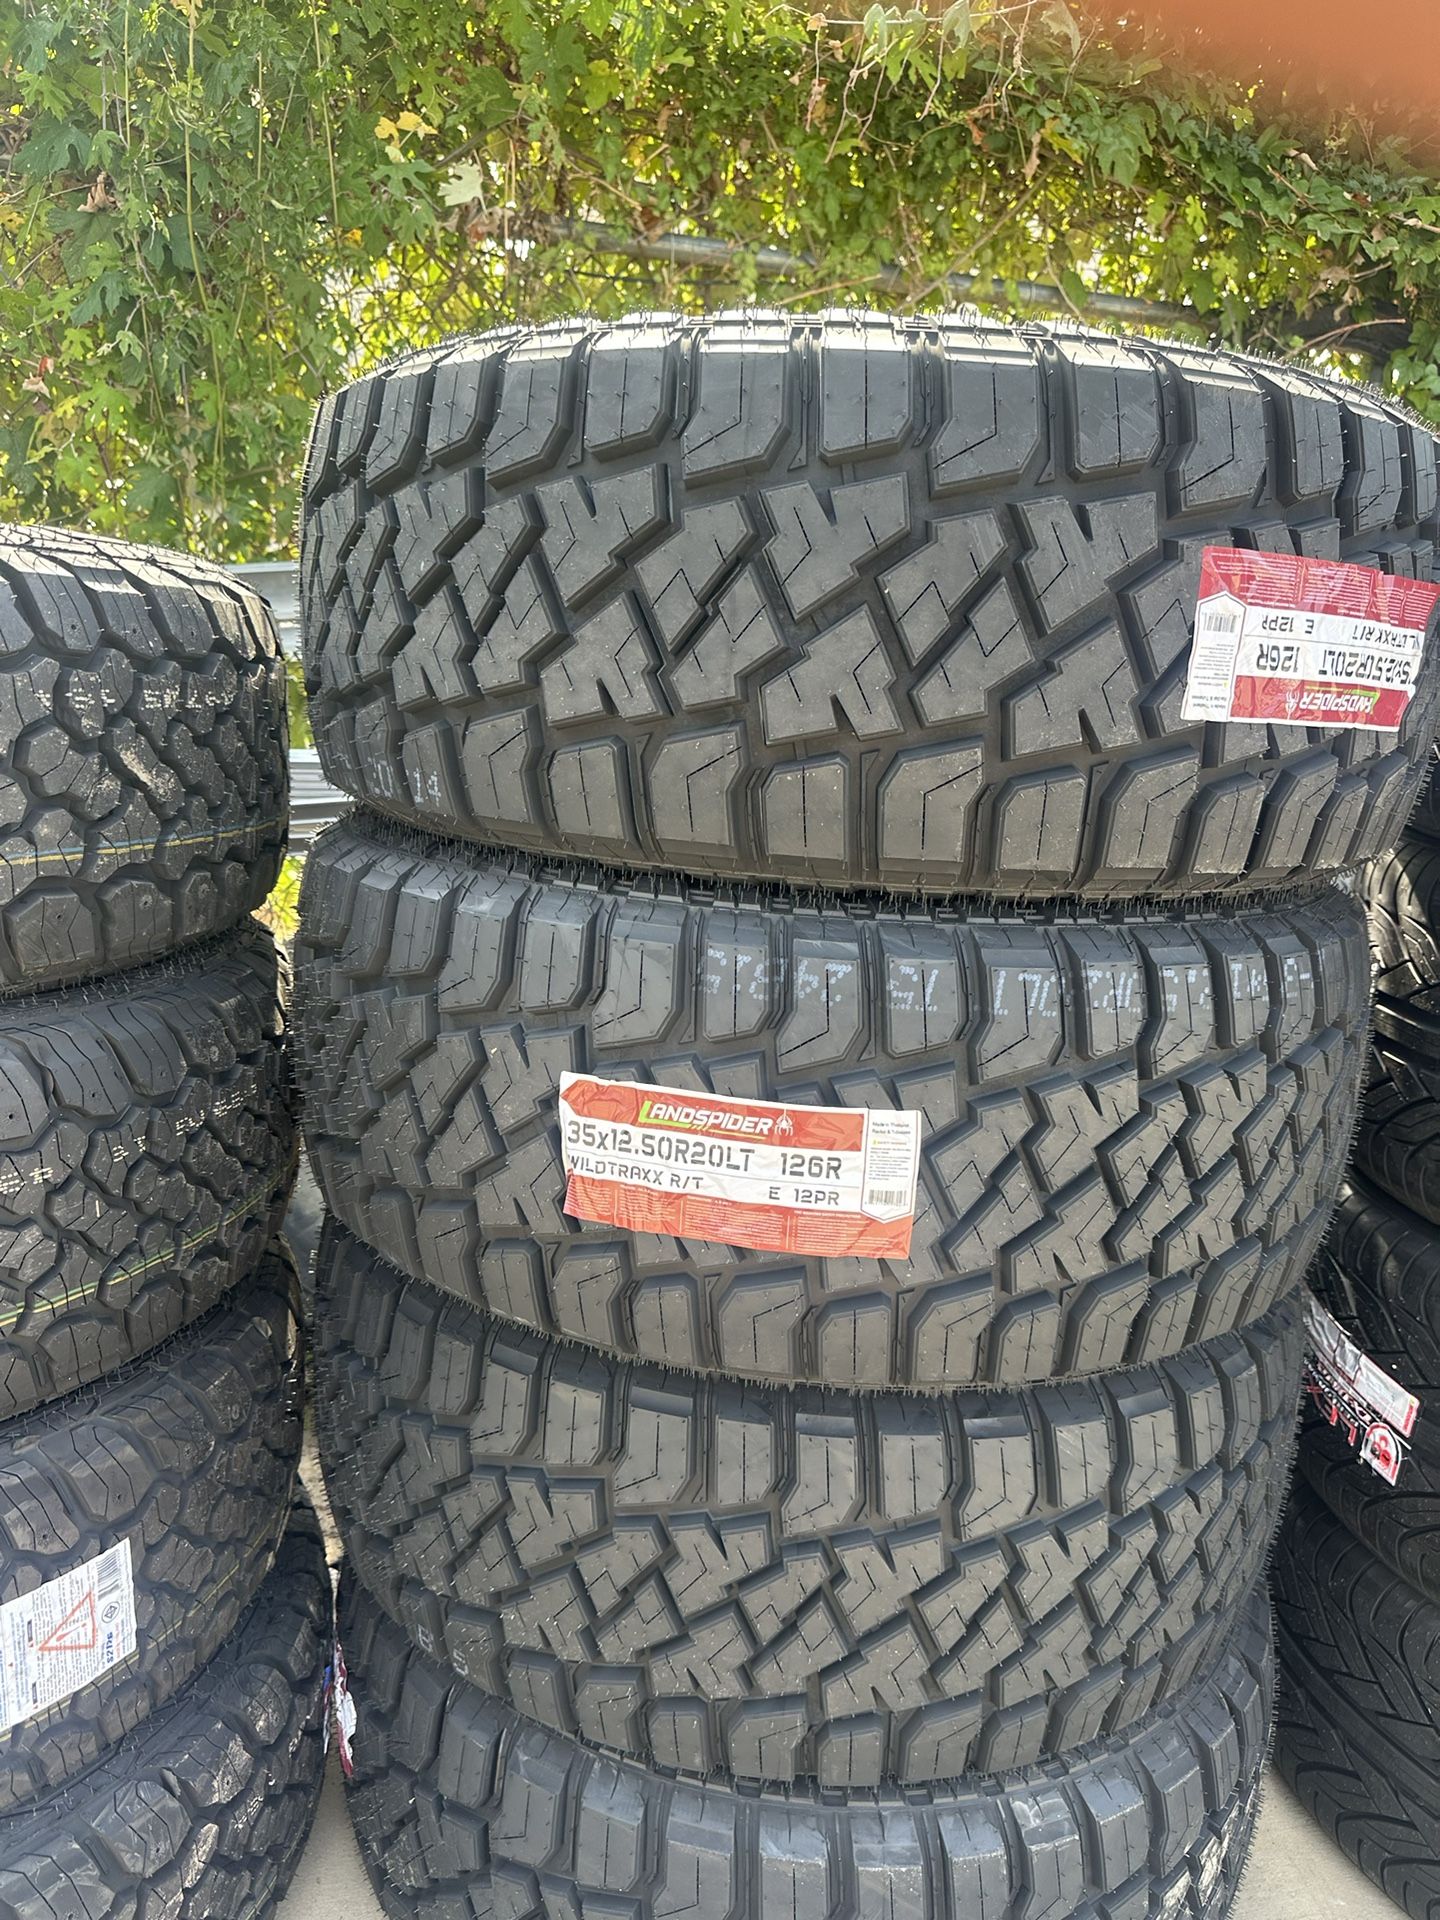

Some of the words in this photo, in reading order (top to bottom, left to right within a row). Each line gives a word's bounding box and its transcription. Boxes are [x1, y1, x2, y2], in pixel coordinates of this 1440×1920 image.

[1305, 619, 1314, 634] E
[1256, 643, 1300, 672] 126R
[638, 1100, 773, 1136] LANDSPIDER
[567, 1120, 755, 1172] 35x12.50R20LT
[781, 1152, 842, 1180] 126R
[568, 1154, 662, 1185] WILDTRAXX
[670, 1173, 704, 1190] R/T
[769, 1186, 781, 1200] E
[794, 1188, 840, 1206] 12PR
